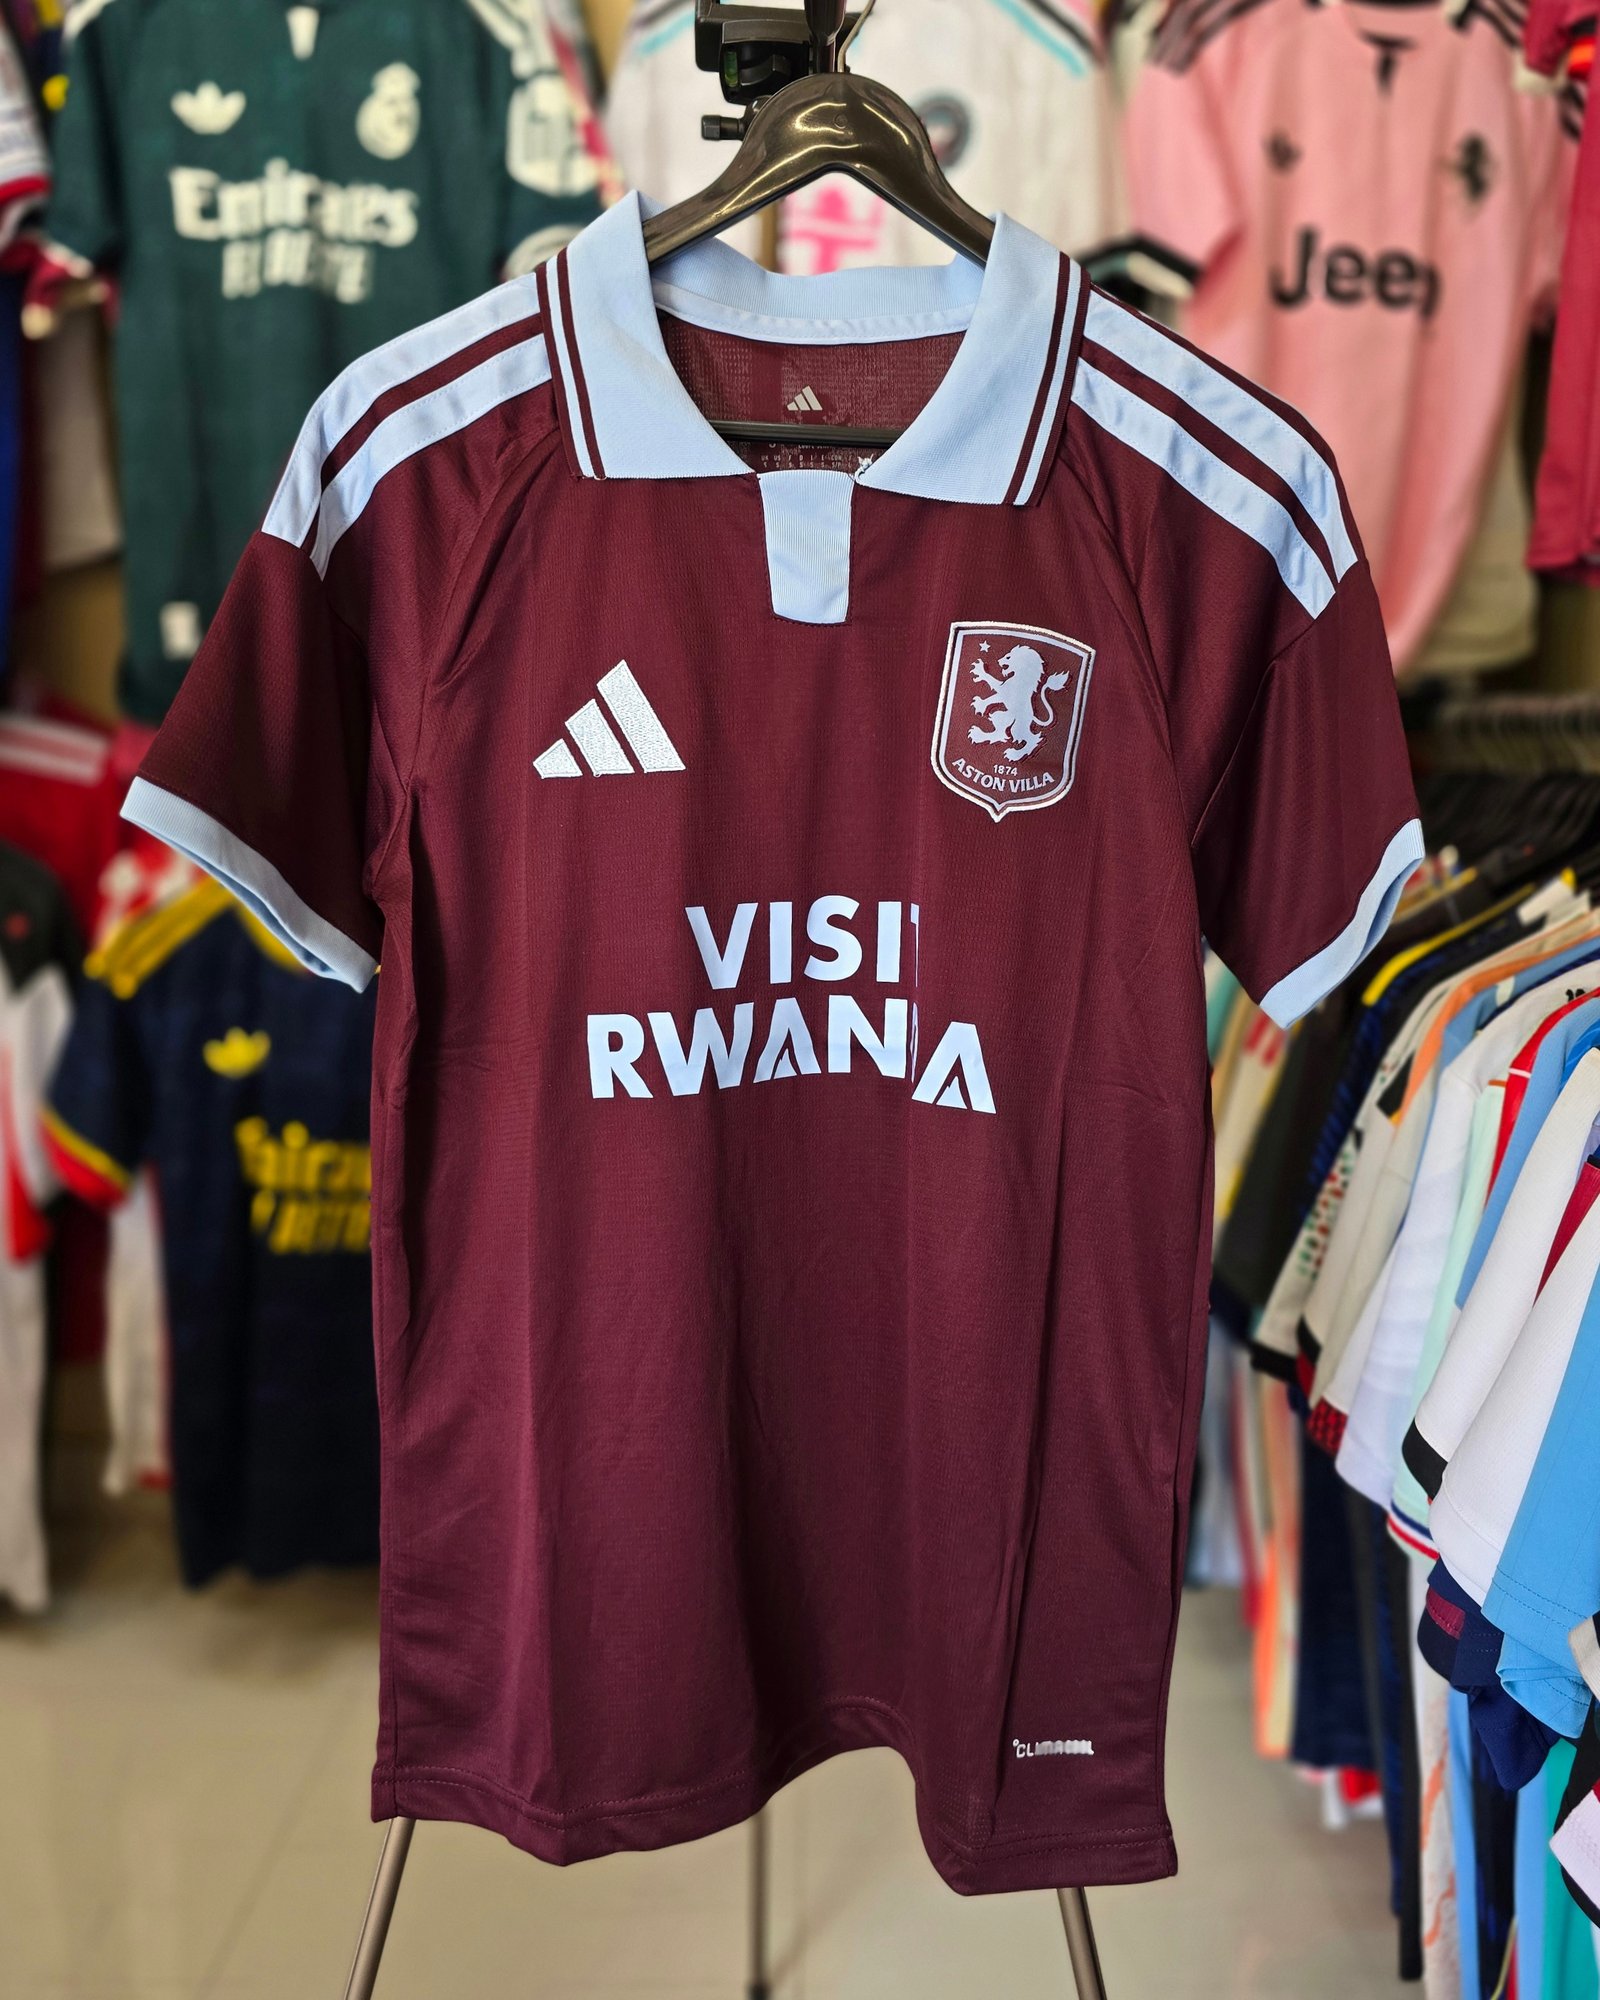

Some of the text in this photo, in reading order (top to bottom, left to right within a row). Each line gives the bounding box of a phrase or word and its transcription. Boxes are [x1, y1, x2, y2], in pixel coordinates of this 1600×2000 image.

[952, 758, 1055, 793] ASTON VILLA
[993, 764, 1018, 776] 1874
[685, 895, 919, 991] VISI
[587, 995, 997, 1114] RWANA
